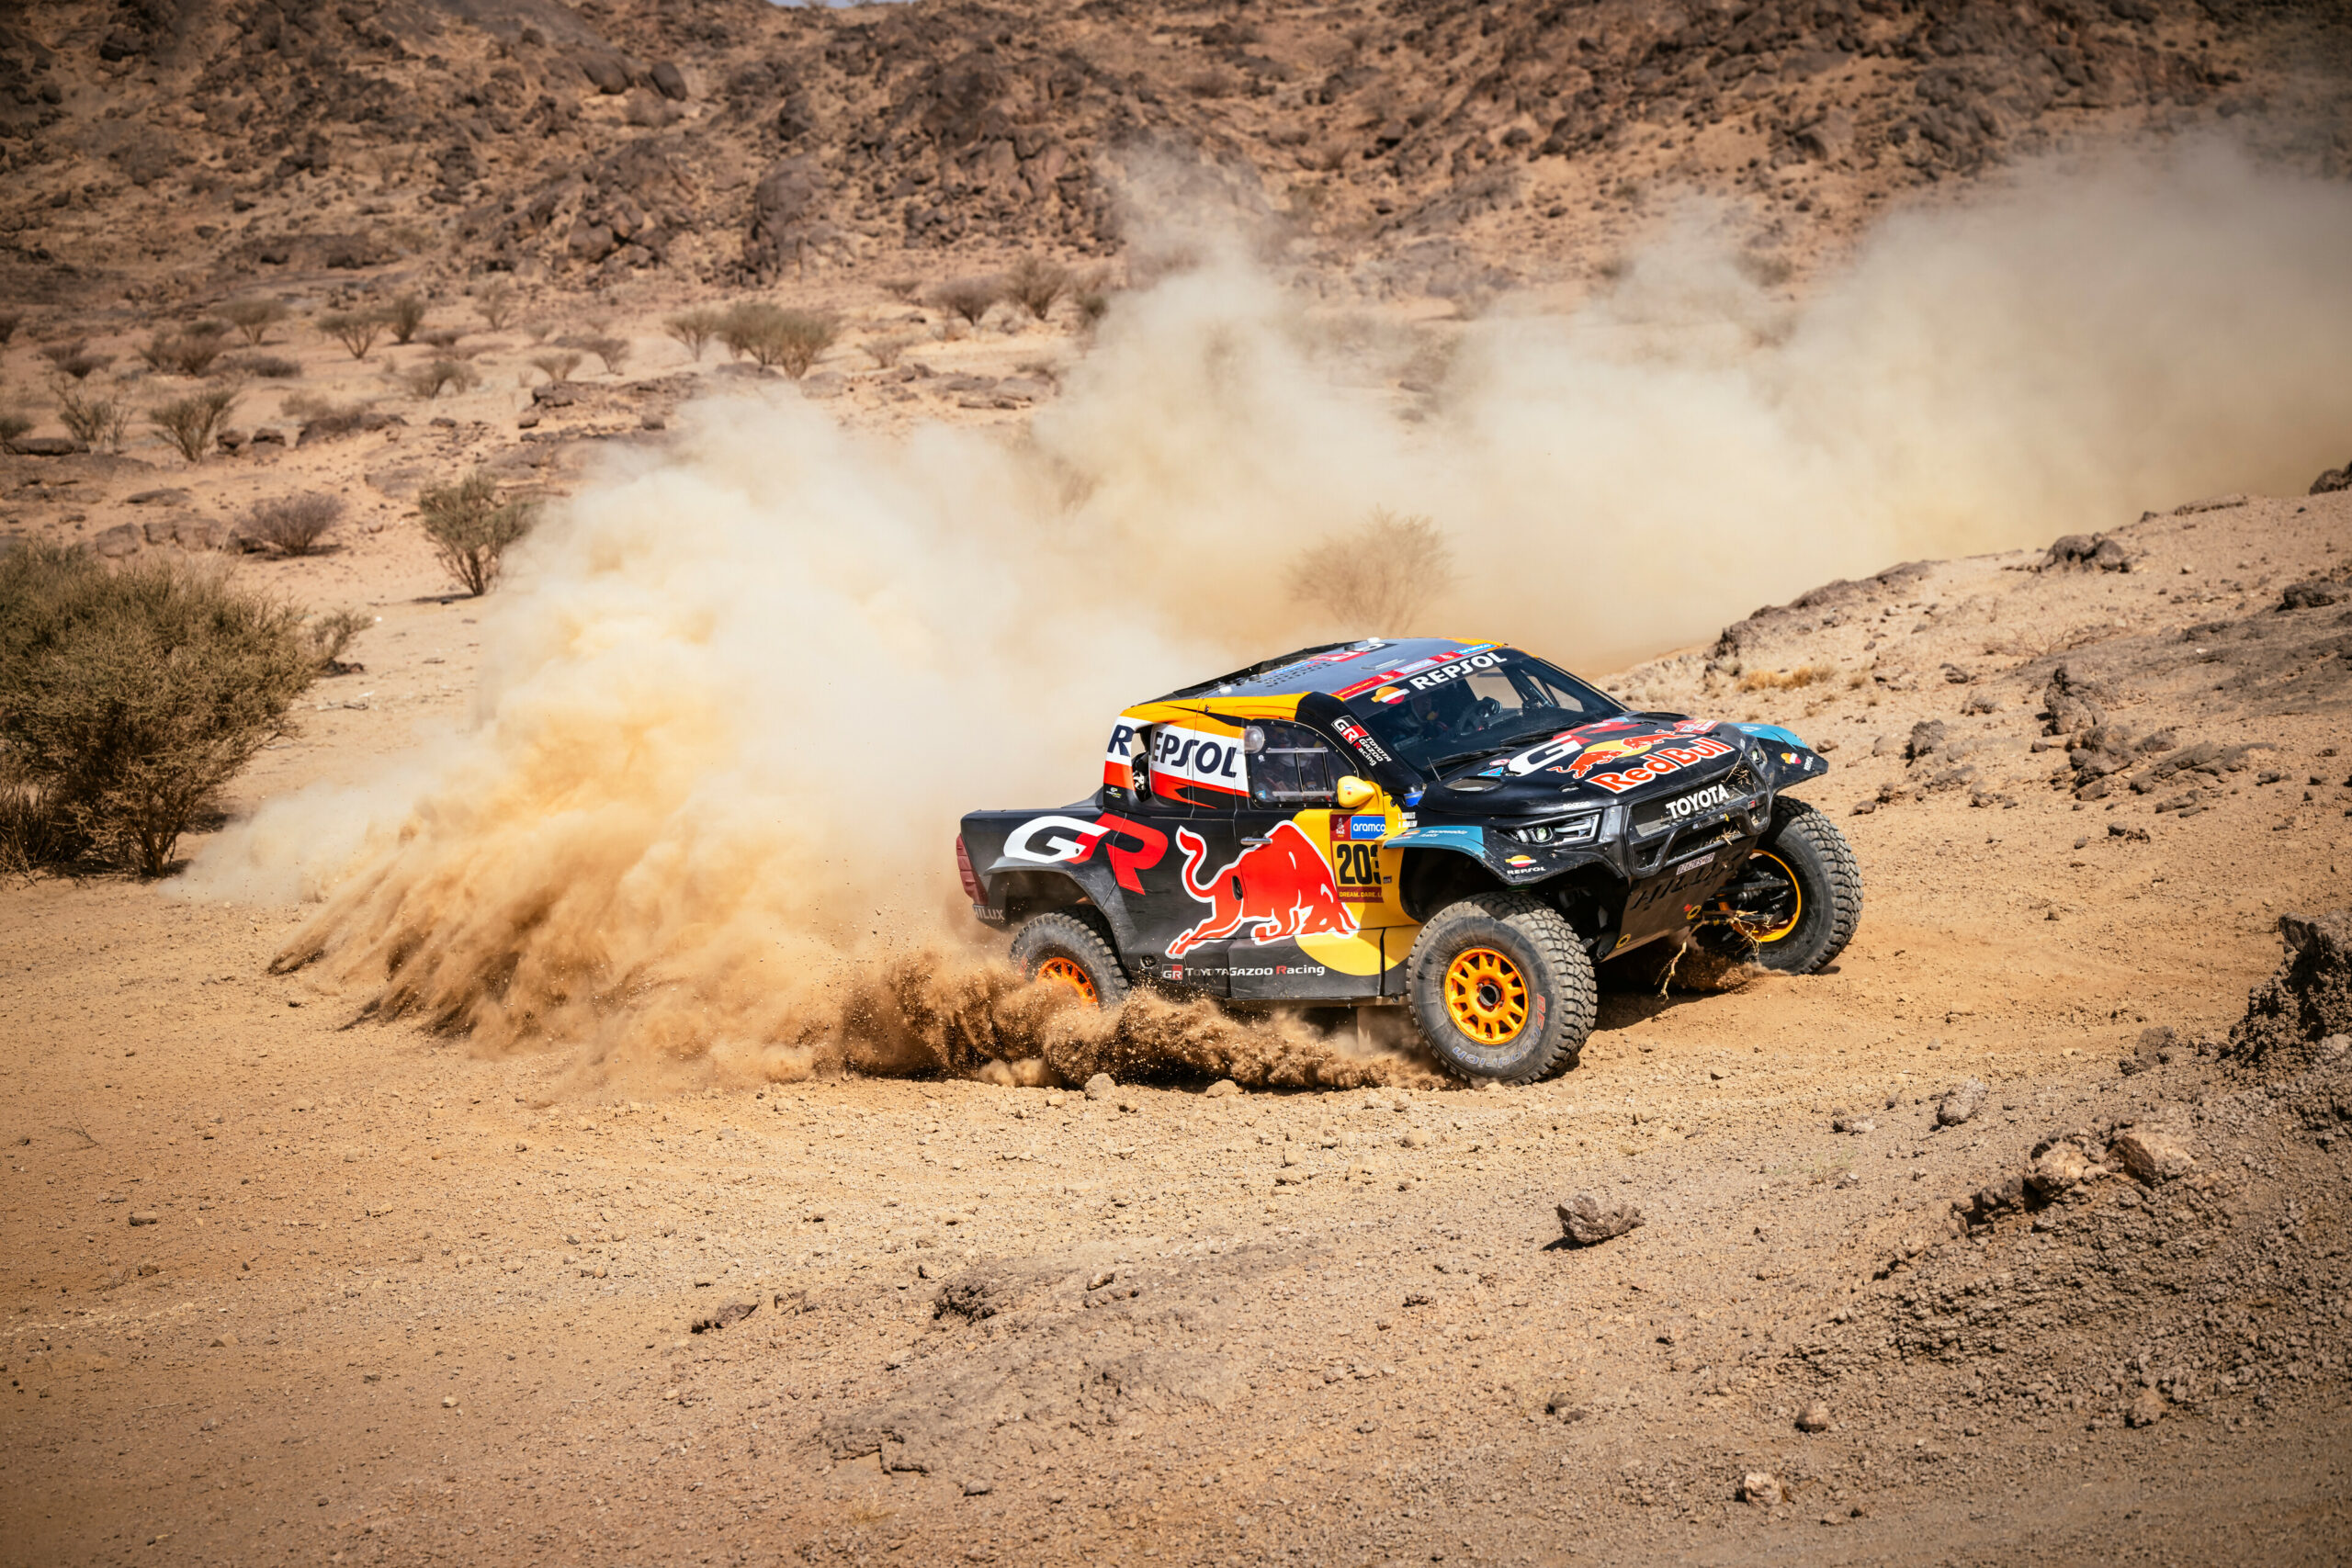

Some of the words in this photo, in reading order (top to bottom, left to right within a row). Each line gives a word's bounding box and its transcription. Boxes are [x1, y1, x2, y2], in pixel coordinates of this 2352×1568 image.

[1409, 652, 1507, 690] REPSOL
[1334, 719, 1359, 741] GR
[1353, 742, 1377, 766] Racing
[1359, 739, 1384, 761] GAZOO
[1366, 737, 1392, 761] TOYOTA
[1666, 784, 1729, 819] TOYOTA
[1352, 823, 1385, 832] aramco
[1003, 811, 1169, 896] GR
[1507, 866, 1546, 874] REPSOL
[1162, 970, 1182, 978] GR
[1229, 967, 1273, 976] GAZOO
[1276, 964, 1325, 976] Racing
